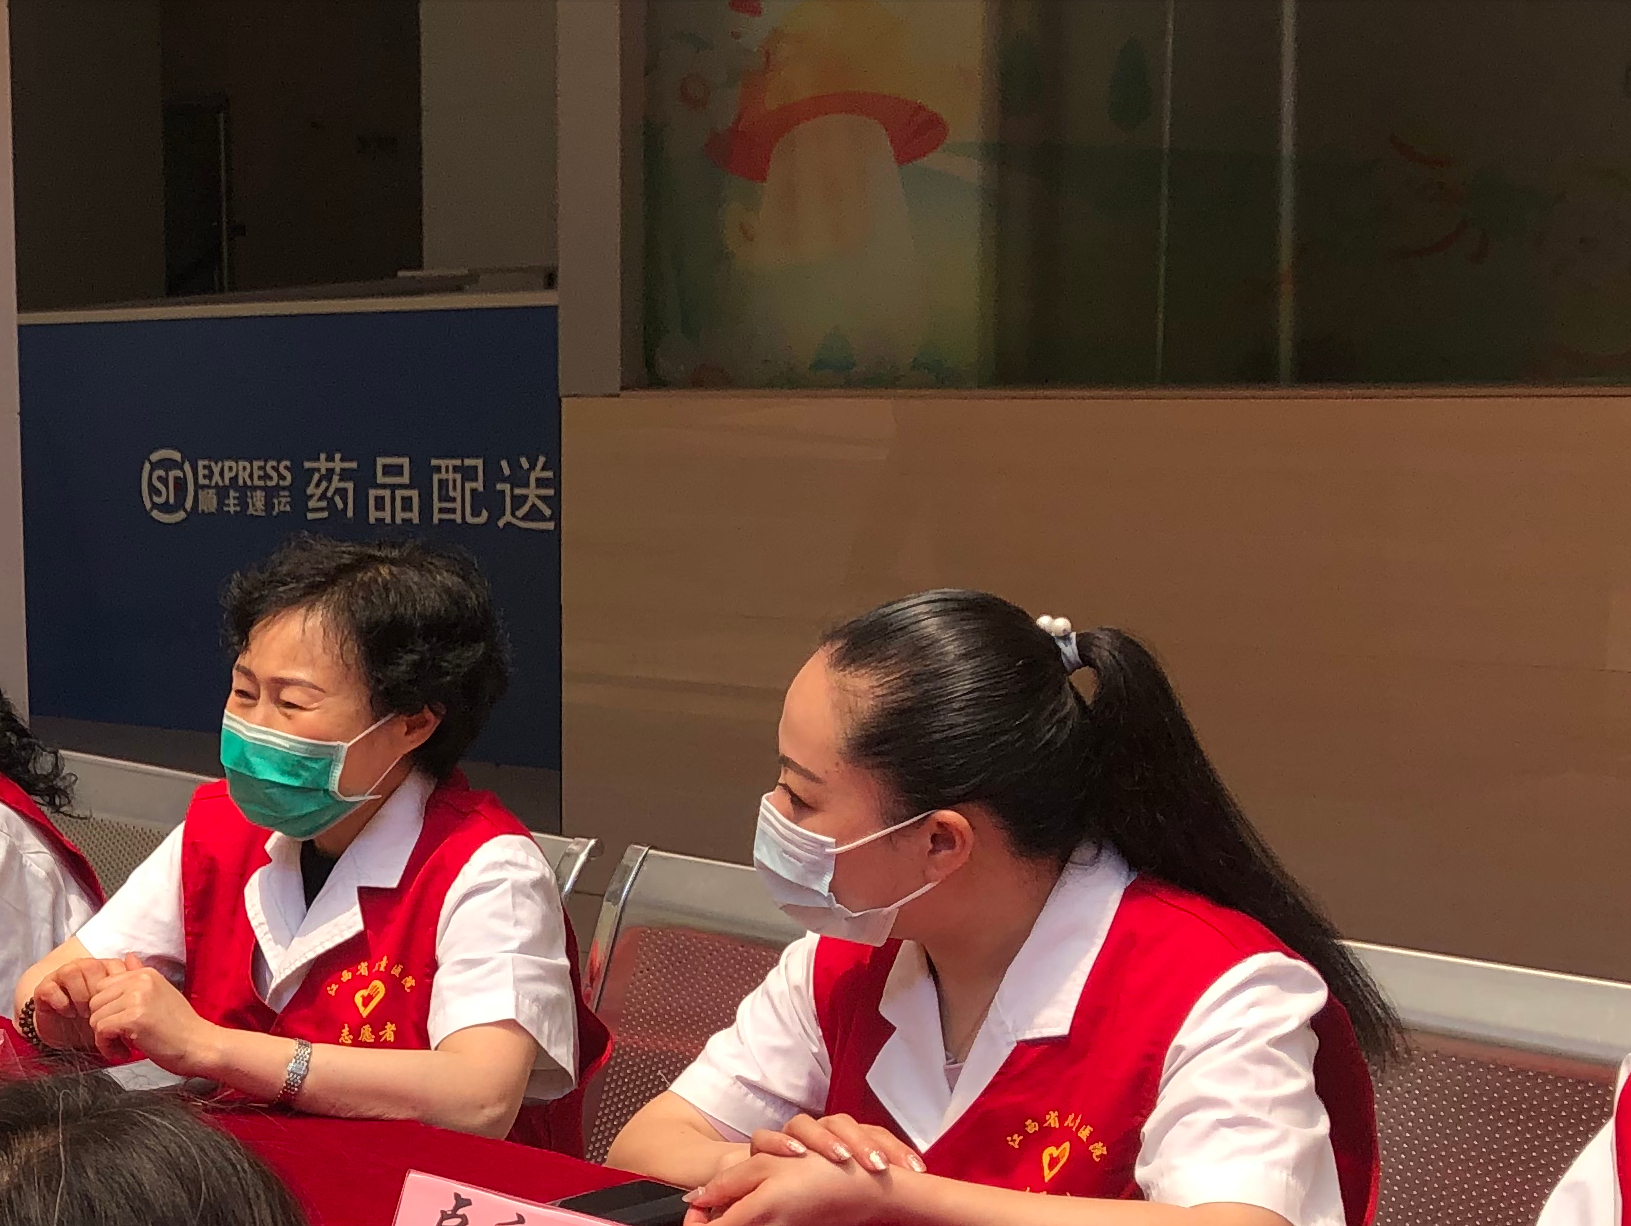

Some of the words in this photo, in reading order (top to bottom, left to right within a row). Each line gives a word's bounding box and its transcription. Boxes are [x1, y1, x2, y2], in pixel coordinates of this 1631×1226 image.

[198, 459, 292, 487] EXPRESS
[198, 490, 292, 516] 顺丰速运
[303, 452, 556, 530] 药品配送
[338, 1021, 397, 1044] 志愿者
